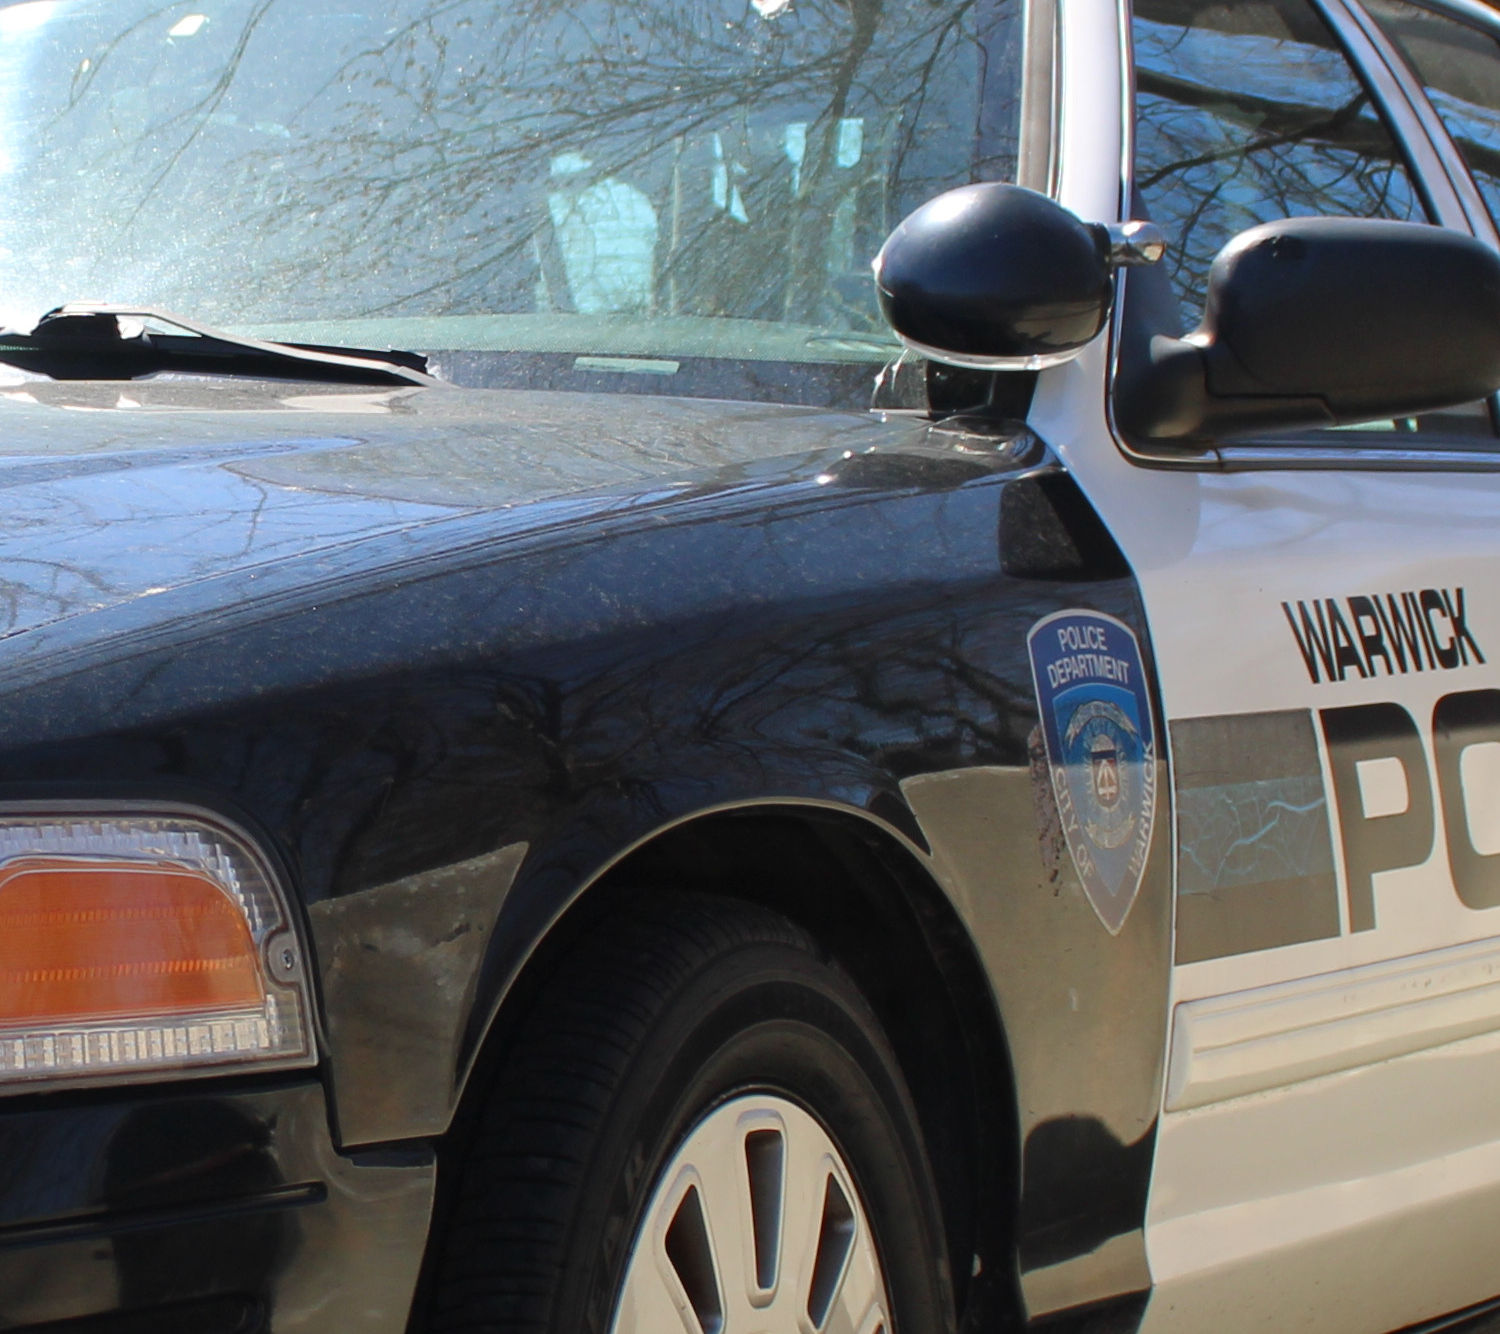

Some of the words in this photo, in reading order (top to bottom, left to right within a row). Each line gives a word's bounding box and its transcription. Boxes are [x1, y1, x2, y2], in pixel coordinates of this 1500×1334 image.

[1046, 653, 1130, 689] DEPARTMENT
[1057, 625, 1109, 653] POLICE
[1281, 587, 1486, 685] WARWICK
[1055, 767, 1079, 833] CITY
[1076, 843, 1096, 877] OF
[1128, 740, 1155, 877] WARWICK
